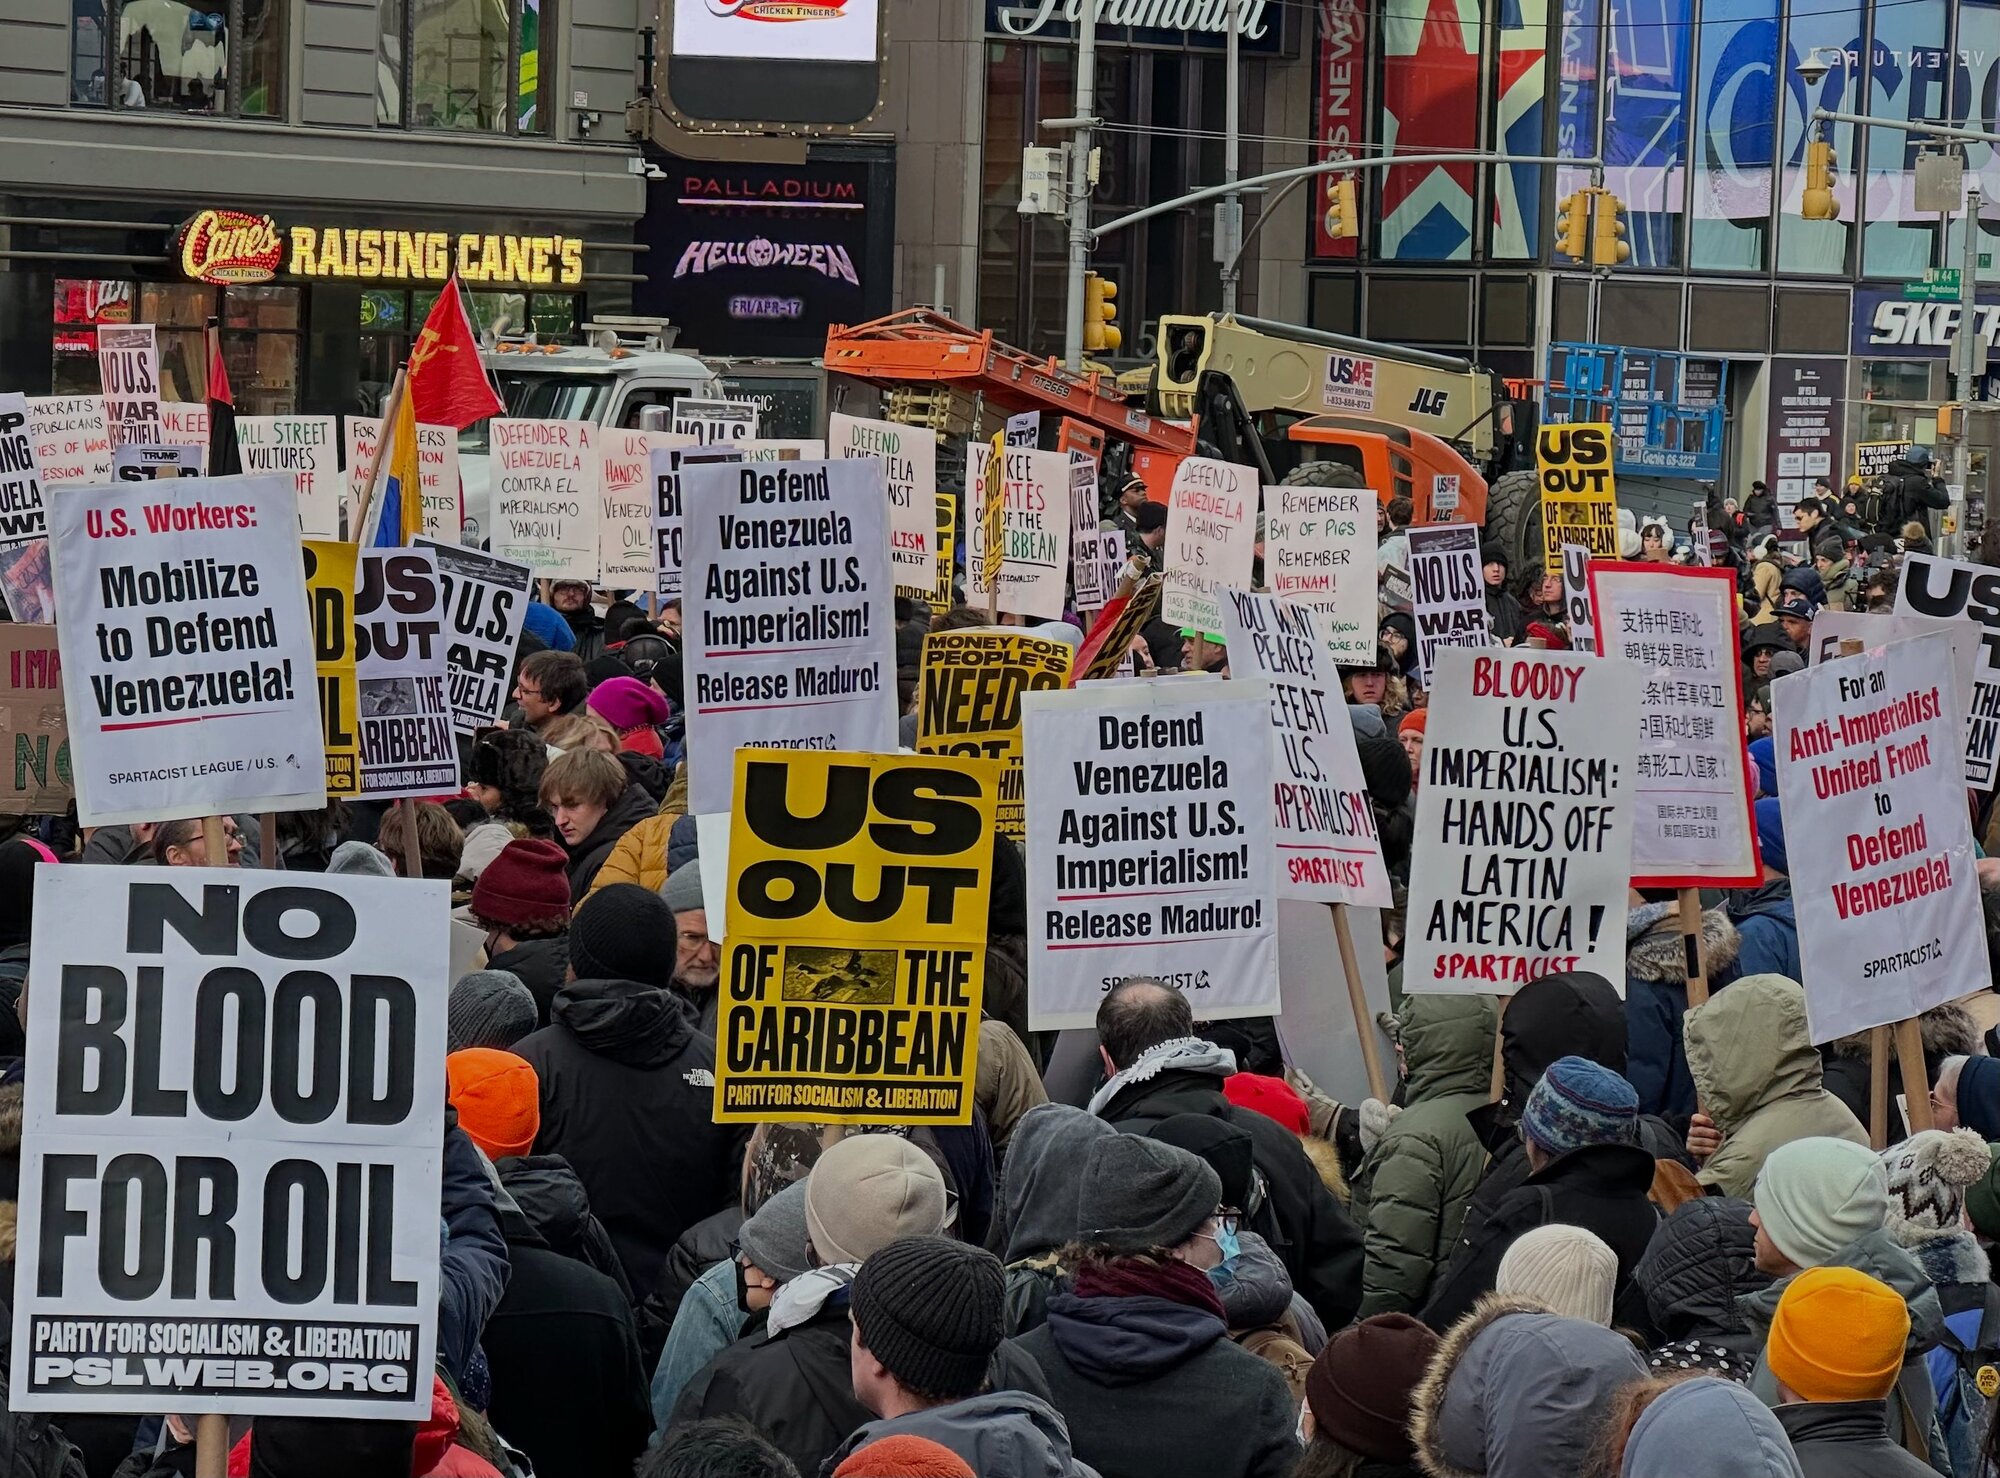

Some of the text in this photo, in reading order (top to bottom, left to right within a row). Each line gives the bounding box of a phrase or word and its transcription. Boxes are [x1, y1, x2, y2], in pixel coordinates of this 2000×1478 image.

[753, 5, 793, 15] CHICKEN
[1329, 0, 1353, 116] NEWS
[1559, 0, 1584, 114] NEWS
[685, 177, 855, 198] PALLADIUM
[182, 209, 281, 279] Cane's
[289, 226, 583, 284] RAISING CANE'S
[673, 234, 860, 286] HELLOWEEN
[211, 267, 240, 279] CHICKEN
[1933, 270, 1952, 282] W 44
[101, 351, 157, 394] NO U.S.
[1031, 375, 1071, 398] RT2669
[1325, 383, 1373, 397] EQUIPMENT RENTAL
[1408, 387, 1449, 416] JLG
[106, 401, 159, 422] WAR
[64, 438, 107, 454] OF WAR
[273, 421, 328, 446] STREET
[354, 421, 377, 439] FOR
[579, 427, 590, 449] A
[852, 423, 900, 455] DEFEND
[1007, 428, 1037, 446] STOP
[1540, 428, 1608, 465] US
[142, 451, 179, 461] TRUMP
[248, 447, 316, 471] VULTURES
[501, 450, 581, 472] VENEZUELA
[1642, 450, 1665, 465] Genie
[1859, 444, 1910, 456] TRUMP IS
[1859, 456, 1867, 466] A
[501, 477, 578, 494] CONTRA EL
[605, 459, 644, 484] HANDS
[739, 466, 831, 505] Defend
[1182, 462, 1239, 493] DEFEND
[1543, 469, 1609, 493] OUT
[1859, 464, 1889, 475] TO US
[500, 501, 580, 518] IMPERIALISMO
[1174, 490, 1243, 522] VENEZUELA
[1282, 491, 1360, 514] REMEMBER
[1432, 508, 1453, 522] JLG
[1545, 501, 1613, 526] OF THE
[86, 507, 137, 540] U.S.
[143, 501, 258, 534] Workers:
[509, 519, 562, 541] YANQUI!
[718, 510, 853, 550] Venezuela
[1018, 511, 1043, 530] THE
[1185, 515, 1234, 543] AGAINST
[1270, 518, 1356, 541] BAY OF PIGS
[1181, 542, 1209, 566] U.S.
[1547, 526, 1616, 554] CARIBBEAN
[1278, 548, 1351, 567] REMEMBER
[100, 557, 259, 609] Mobilize
[354, 555, 437, 616] US
[704, 560, 812, 605] Against
[820, 555, 868, 593] U.S.
[1275, 573, 1336, 593] VIETNAM!
[1413, 556, 1446, 604] NO
[1446, 552, 1482, 600] U.S.
[454, 580, 515, 646] U.S.
[703, 601, 870, 650] Imperialism!
[1229, 590, 1316, 641] YOU WANT
[1331, 620, 1360, 634] KNOW
[1418, 608, 1485, 636] WAR
[1620, 608, 1704, 638] 支持中国和北
[96, 607, 278, 663] to Defend
[927, 636, 1069, 658] MONEY FOR
[1451, 628, 1462, 637] ON
[926, 650, 1067, 673] PEOPLE'S
[1252, 632, 1317, 681] PEACE?
[90, 658, 295, 717] Venezuela!
[416, 676, 447, 714] THE
[696, 661, 880, 704] Release Maduro!
[1472, 656, 1586, 704] BLOODY
[1838, 669, 1887, 703] For an
[1099, 711, 1205, 751] Defend
[1502, 705, 1565, 752] U.S.
[1789, 685, 1942, 763] Anti-Imperialist
[108, 756, 279, 785] SPARTACIST LEAGUE U.S.
[1280, 732, 1327, 783] U.S.
[1429, 747, 1619, 799] IMPERIALISM:
[1811, 750, 1882, 801] United
[1885, 734, 1932, 779] Front
[366, 766, 455, 788] FOR SOCIALISM LIBERATION
[1073, 754, 1229, 797] Venezuela
[744, 761, 984, 857] US
[1874, 792, 1893, 817] to
[1058, 799, 1246, 849] Against U.S.
[1441, 797, 1616, 853] HANDS OFF
[1846, 813, 1928, 872] Defend
[1056, 844, 1249, 893] Imperialism!
[1287, 855, 1365, 889] SPARTACIST
[1460, 853, 1568, 900] LATIN
[737, 859, 980, 925] OUT
[1831, 852, 1954, 921] Venezuela!
[126, 882, 357, 961] NO
[1046, 898, 1262, 941] Release Maduro!
[730, 943, 974, 1007] OF THE
[1433, 953, 1582, 984] SPARTACIST
[1863, 945, 1934, 979] SPARTACIST
[55, 964, 417, 1125] BLOOD
[727, 1004, 967, 1077] CARIBBEAN
[727, 1084, 958, 1111] PARTY FOR SOCIALISM & LIBERATION
[36, 1152, 419, 1308] FOR OIL
[36, 1321, 412, 1361] PARTY FOR SOCIALISM & LIBERATION
[34, 1357, 409, 1394] PSLWEB.ORG
